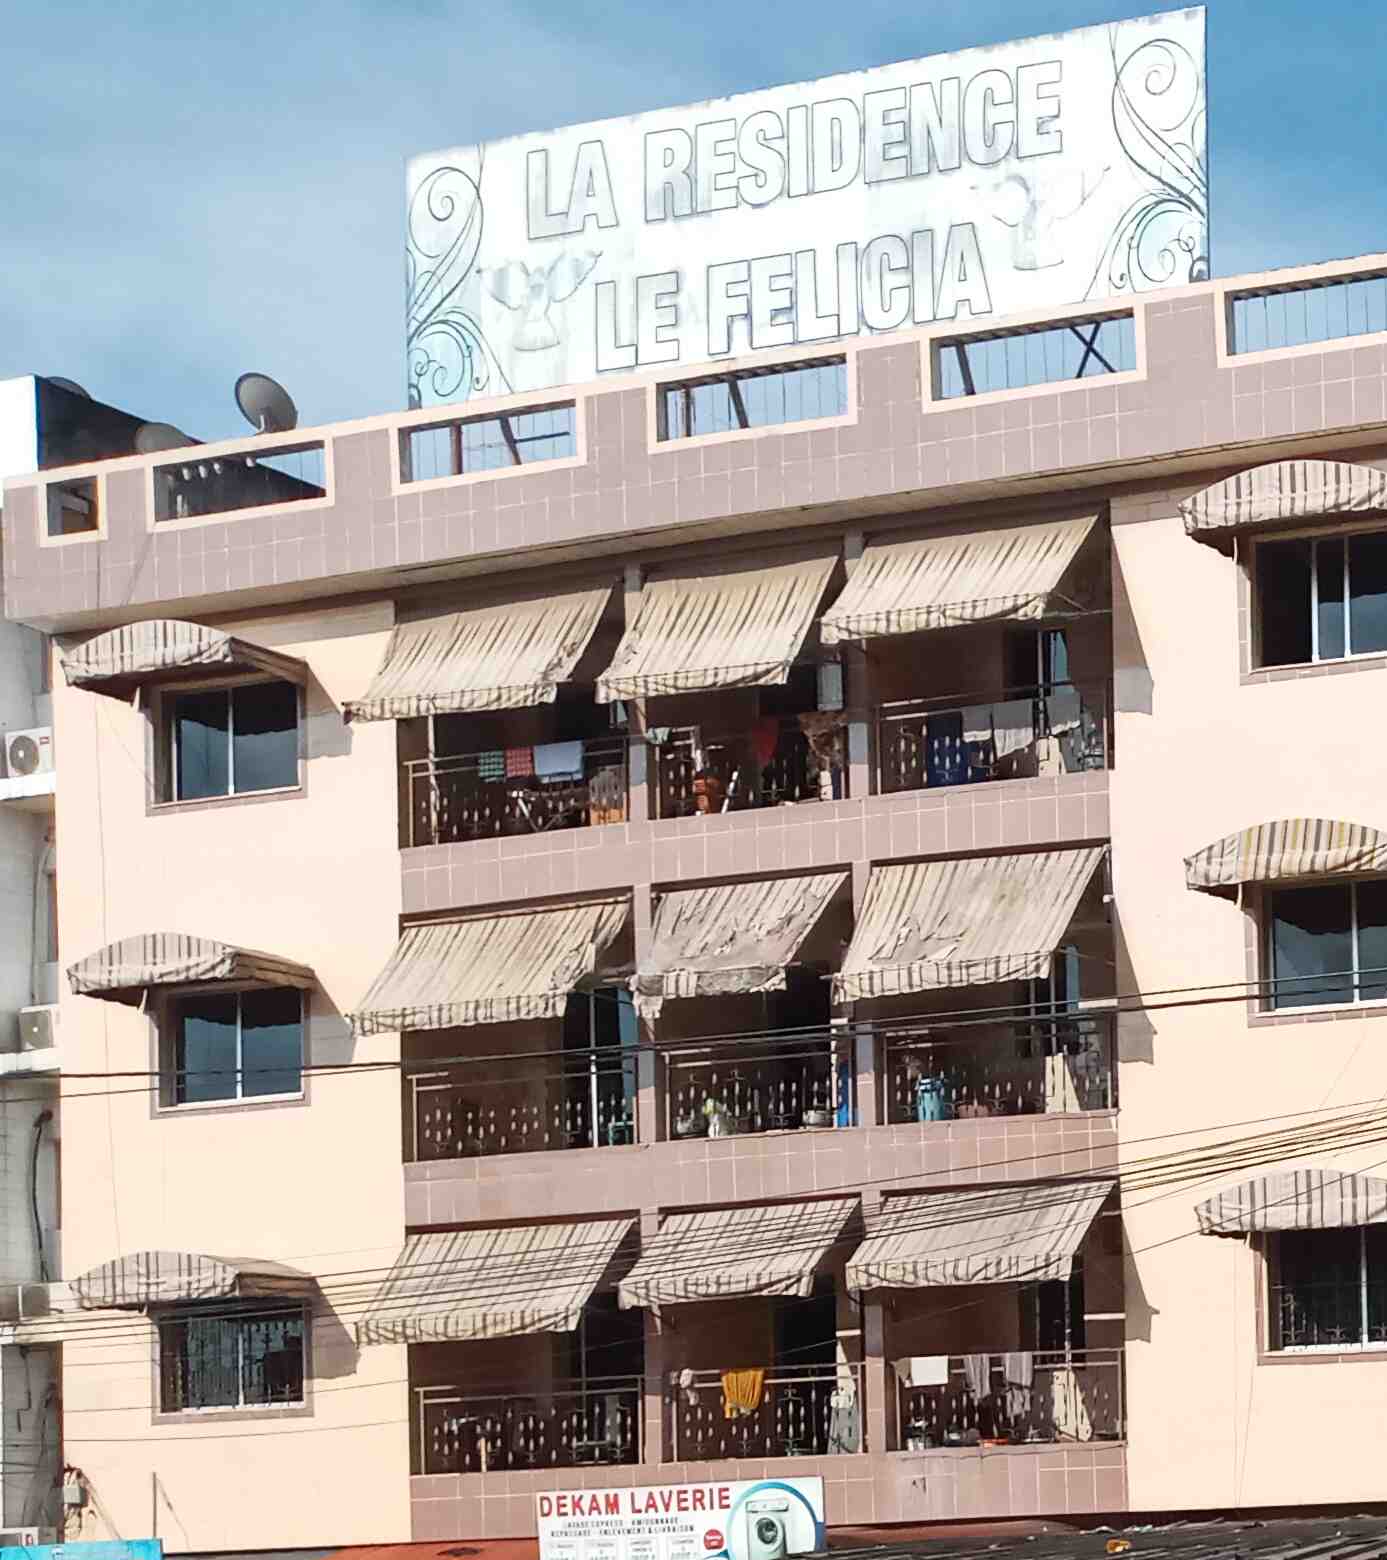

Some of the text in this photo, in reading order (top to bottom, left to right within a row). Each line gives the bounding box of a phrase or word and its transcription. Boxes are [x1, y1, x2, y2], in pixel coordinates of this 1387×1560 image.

[525, 60, 1063, 241] LA RESIDENCE
[595, 221, 993, 373] LE FELICIA
[539, 1487, 731, 1517] DEKAM LAVERIE
